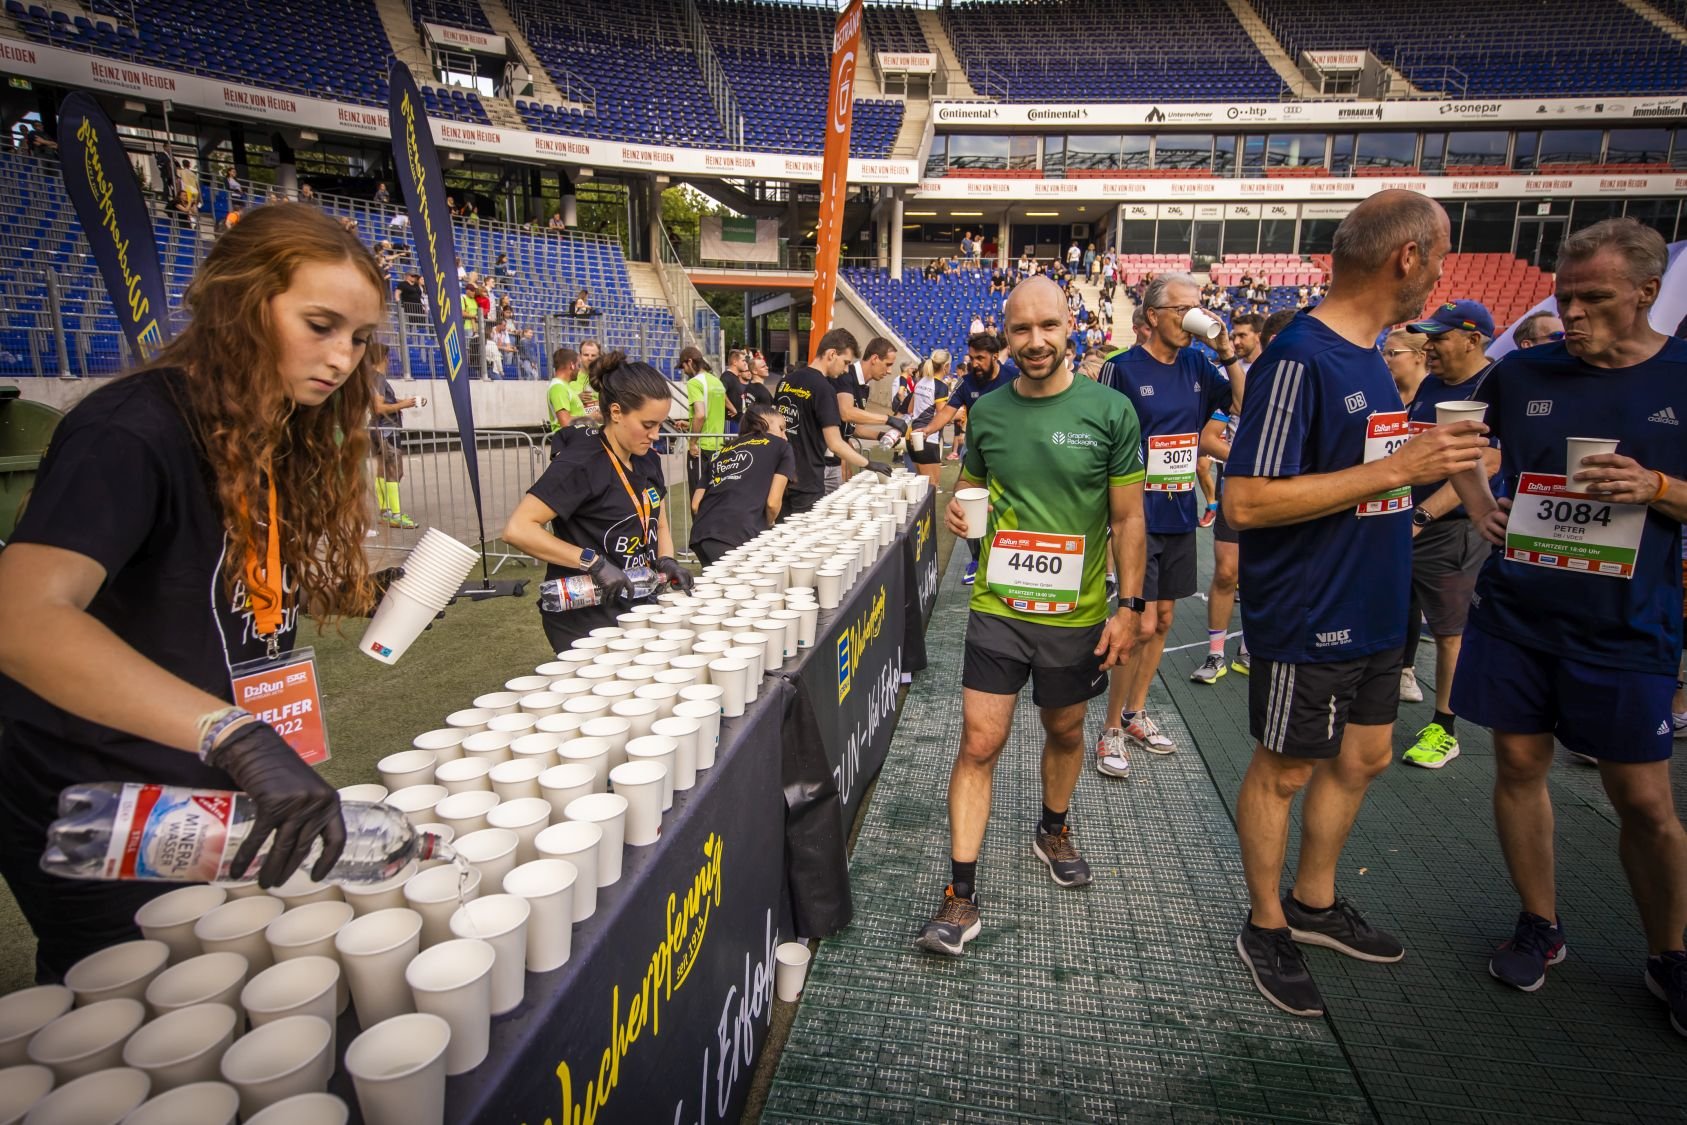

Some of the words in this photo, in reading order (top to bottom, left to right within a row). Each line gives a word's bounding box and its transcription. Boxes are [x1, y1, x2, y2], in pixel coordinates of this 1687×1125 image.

[443, 28, 458, 40] HEINZ
[460, 33, 469, 42] VON
[469, 34, 488, 45] HEIDEN
[0, 42, 36, 64] HEIDEN
[883, 56, 898, 65] HEINZ
[900, 57, 909, 65] VON
[910, 56, 929, 66] HEIDEN
[91, 61, 119, 79] HEINZ
[122, 69, 140, 84] VON
[142, 72, 176, 91] HEIDEN
[223, 88, 248, 105] HEINZ
[250, 94, 266, 107] VON
[267, 95, 296, 112] HEIDEN
[939, 108, 991, 120] Continental
[1028, 108, 1080, 121] Continental
[1250, 106, 1267, 116] htp
[1338, 108, 1374, 117] HYDRAULIK
[1454, 103, 1502, 114] sonepar
[338, 108, 360, 123] HEINZ
[362, 113, 376, 125] VON
[378, 114, 390, 128] HEI
[441, 125, 461, 139] HEINZ
[462, 129, 476, 140] VON
[476, 130, 500, 144] HEIDEN
[535, 138, 553, 150] HEINZ
[555, 142, 567, 152] VON
[567, 143, 590, 155] HEIDEN
[622, 148, 640, 159] HEINZ
[640, 151, 652, 161] VON
[653, 151, 674, 162] HEIDEN
[705, 155, 722, 166] HEINZ
[723, 158, 734, 167] VON
[735, 157, 755, 168] HEIDEN
[785, 160, 801, 171] HEINZ
[802, 162, 813, 171] VON
[813, 162, 823, 172] HEI
[862, 164, 877, 174] HEINZ
[879, 166, 889, 174] VON
[890, 165, 909, 175] HEIDEN
[968, 183, 982, 192] HEINZ
[983, 184, 992, 192] VON
[993, 183, 1010, 192] HEIDEN
[1035, 183, 1049, 192] HEINZ
[1050, 184, 1059, 192] VON
[1060, 183, 1078, 192] HEIDEN
[1103, 183, 1117, 192] HEINZ
[1118, 184, 1127, 192] VON
[1128, 183, 1146, 192] HEIDEN
[1171, 183, 1185, 192] HEINZ
[1186, 184, 1196, 192] VON
[1197, 183, 1214, 192] HEIDEN
[1240, 183, 1255, 192] HEINZ
[1256, 184, 1265, 192] VON
[1266, 183, 1284, 192] HEIDEN
[1310, 183, 1325, 191] HEINZ
[1336, 183, 1355, 191] HEIDEN
[1381, 182, 1396, 190] HEINZ
[1408, 182, 1426, 190] HEIDEN
[1452, 181, 1468, 190] HEINZ
[1469, 182, 1479, 190] VON
[1479, 181, 1499, 190] HEIDEN
[1526, 180, 1541, 189] HEINZ
[1542, 181, 1552, 189] VON
[1553, 180, 1573, 189] HEIDEN
[1600, 179, 1616, 188] HEINZ
[1616, 180, 1627, 188] VON
[1627, 179, 1648, 188] HEIDEN
[1675, 178, 1687, 187] HEIN
[1348, 394, 1365, 411] DB
[1529, 402, 1550, 414] DB
[1648, 415, 1679, 426] adidas
[1067, 438, 1097, 446] Packaging
[1163, 449, 1192, 464] 3073
[1537, 500, 1611, 527] 3084
[1554, 525, 1585, 535] PETER
[615, 526, 658, 554] B2N
[1534, 541, 1568, 551] STARTZEIT
[1008, 552, 1062, 574] 4460
[881, 645, 901, 719] Erfol
[244, 680, 284, 698] B2Run
[256, 699, 312, 724] ELFER
[275, 718, 303, 736] 022
[160, 822, 183, 866] WASSER
[172, 813, 200, 873] MINERAL
[676, 958, 689, 980] seit
[687, 916, 705, 957] 1914
